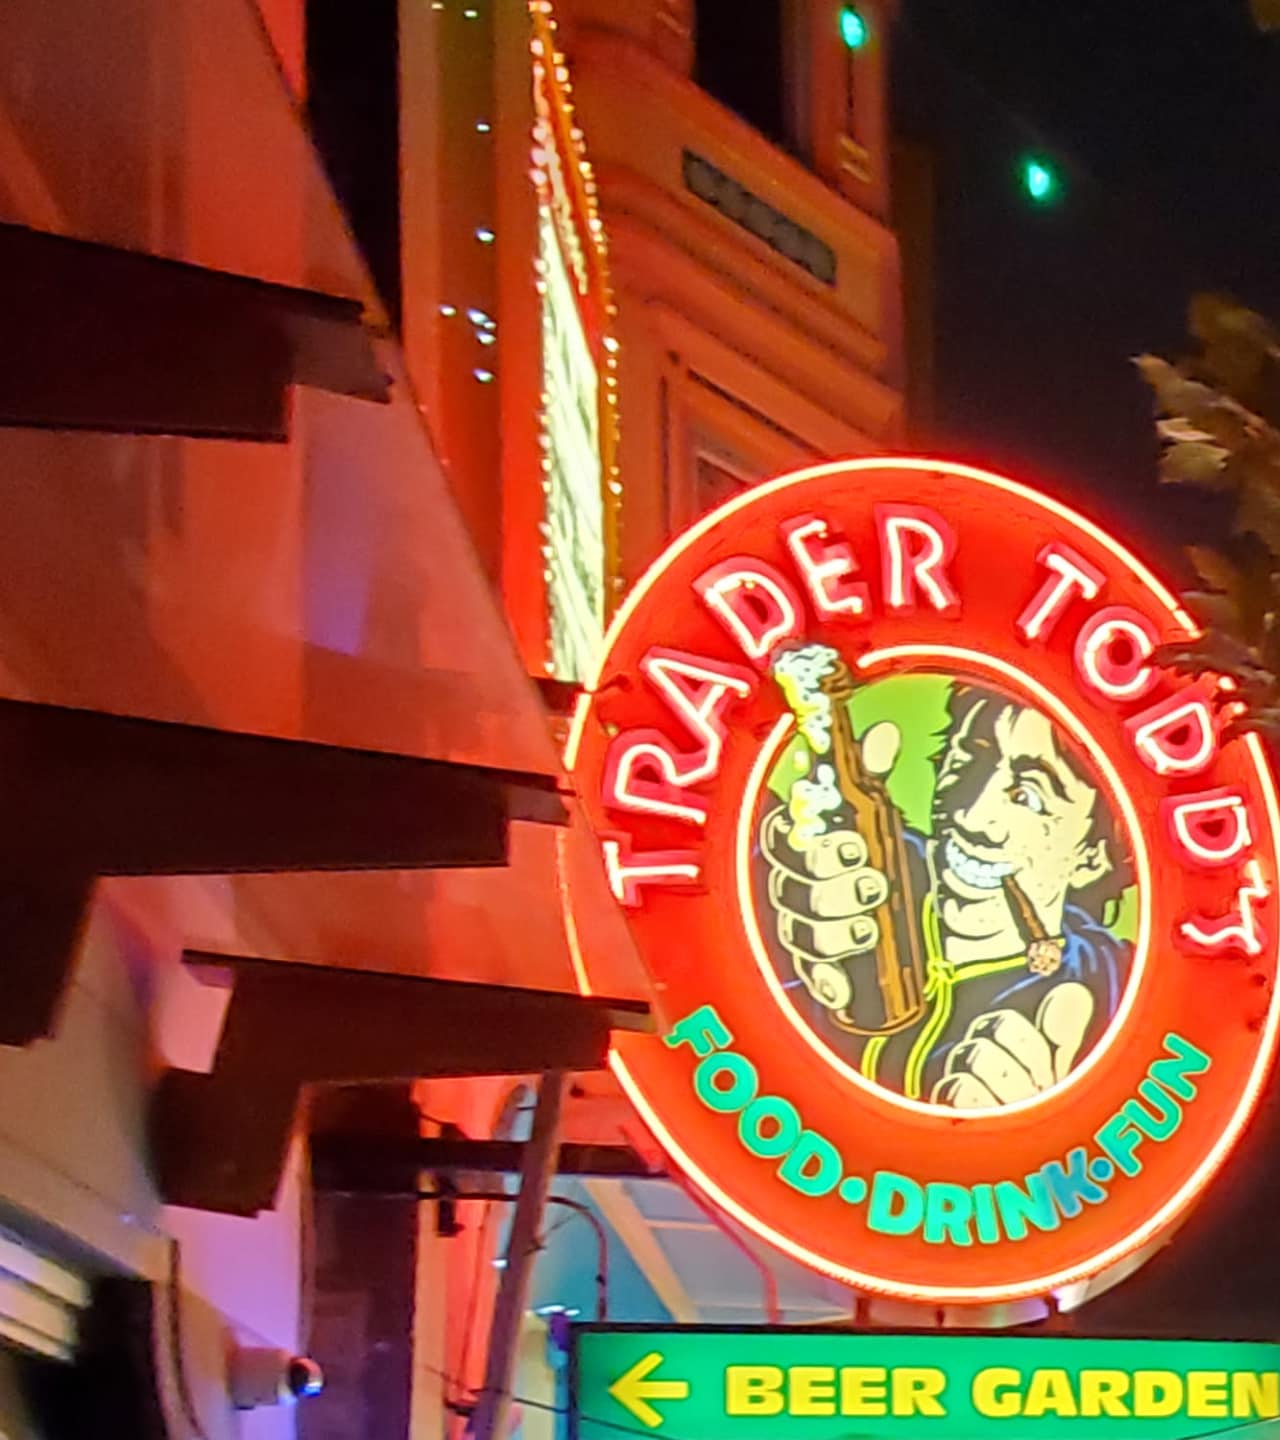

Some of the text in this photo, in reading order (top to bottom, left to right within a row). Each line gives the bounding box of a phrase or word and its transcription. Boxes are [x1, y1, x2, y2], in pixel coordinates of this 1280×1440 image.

[602, 505, 960, 906] TRADER
[664, 1004, 1213, 1247] FOOD DRINK FUN
[725, 1364, 947, 1418] BEER
